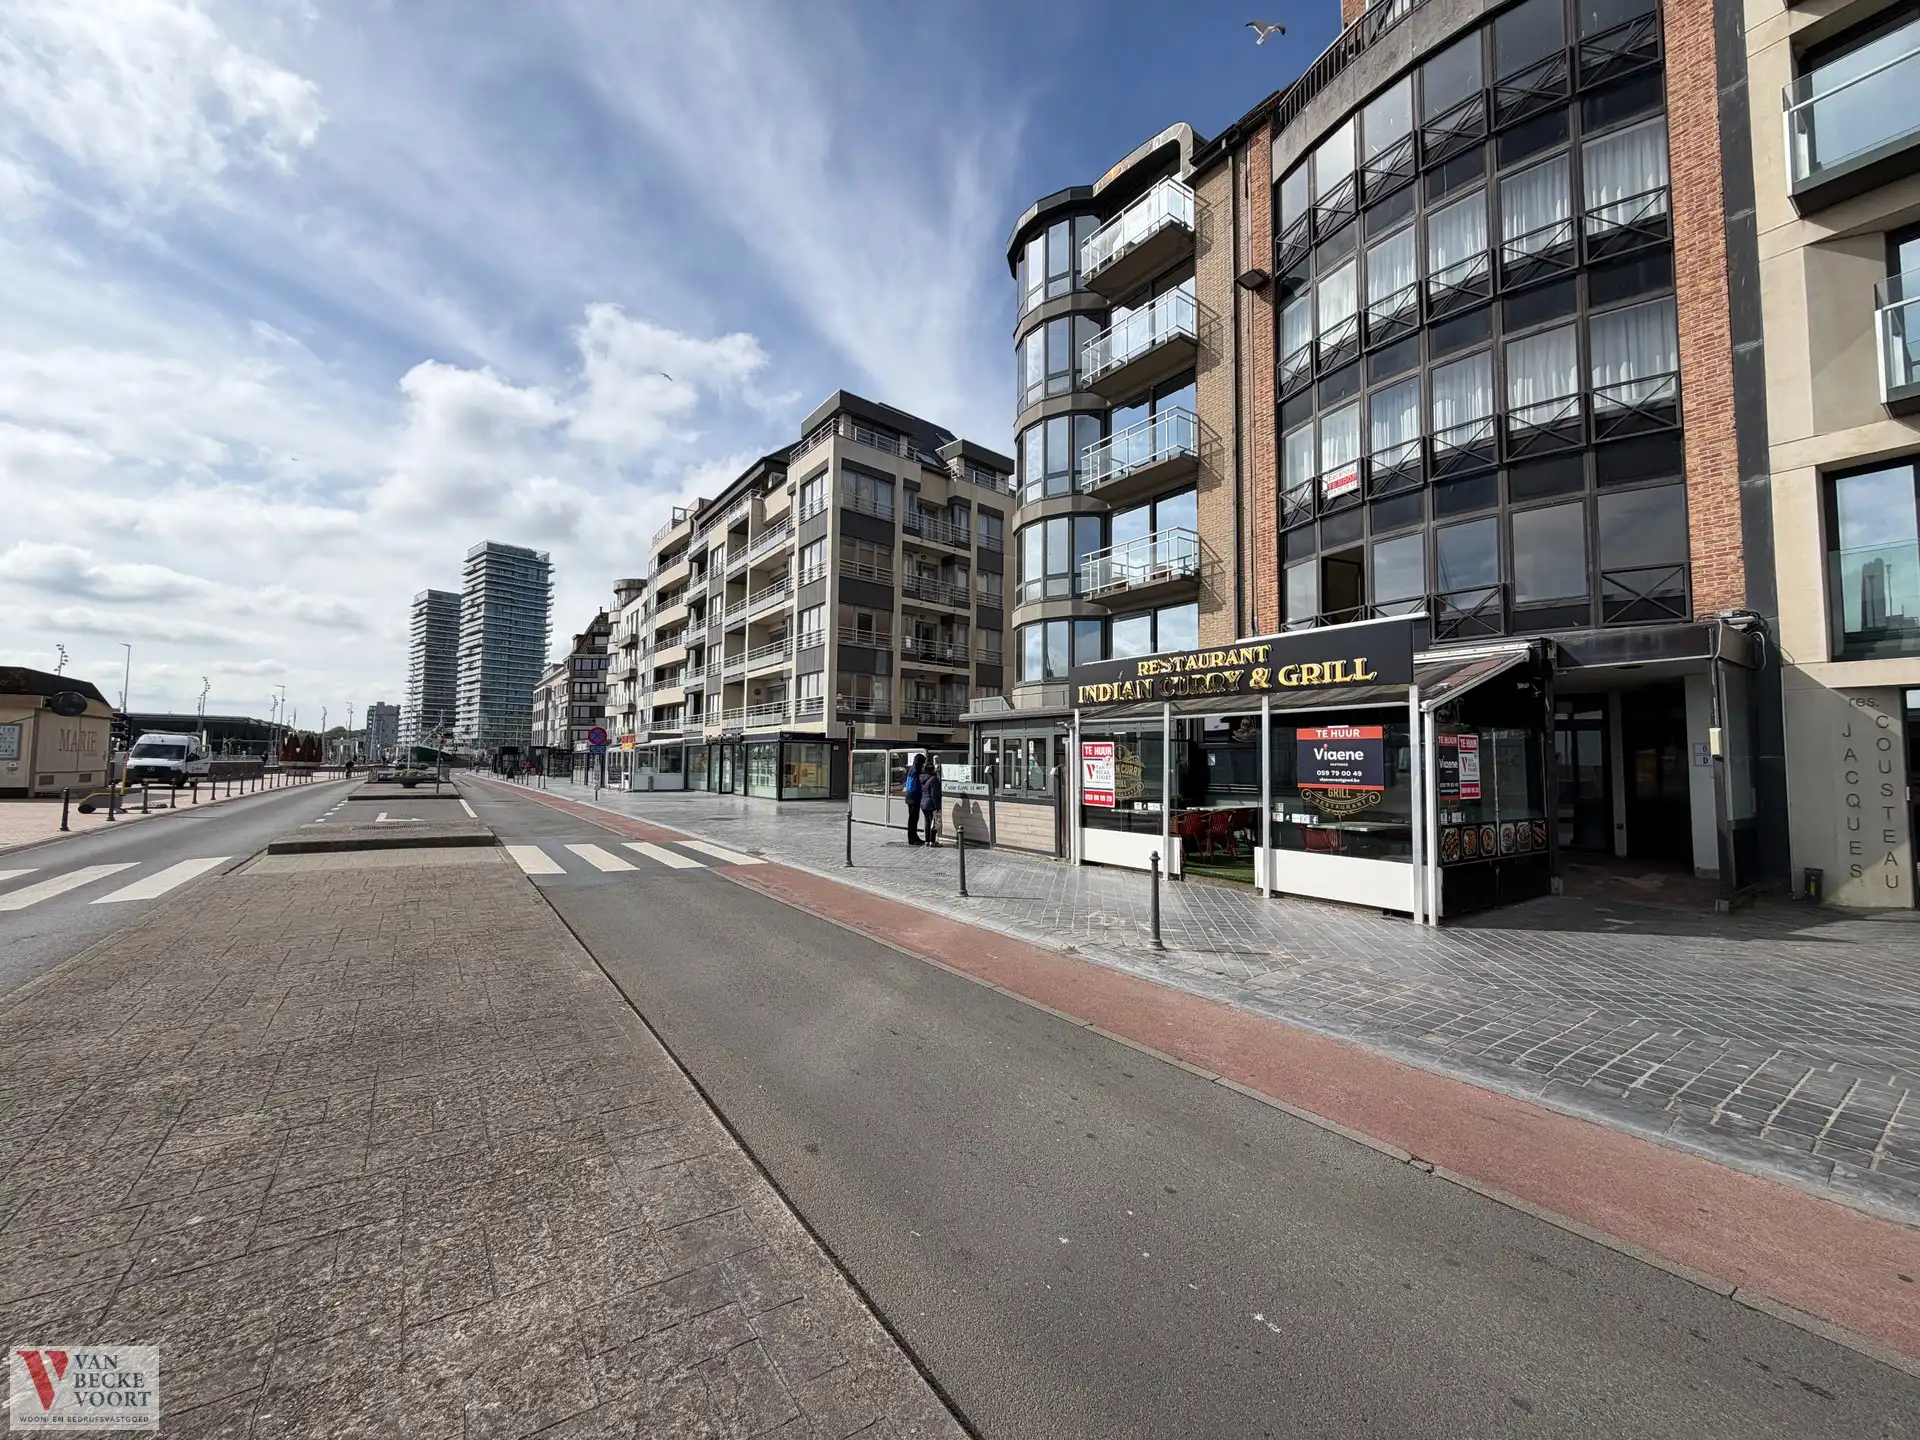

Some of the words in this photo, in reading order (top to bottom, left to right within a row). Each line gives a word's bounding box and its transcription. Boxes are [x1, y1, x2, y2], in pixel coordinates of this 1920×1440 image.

[1137, 644, 1272, 677] RESTAURANT
[1077, 678, 1154, 704] INDIAN
[1160, 669, 1244, 698] CURRY
[1249, 667, 1272, 689] &
[1278, 657, 1378, 687] GRILL
[1849, 697, 1879, 707] res.
[58, 728, 98, 752] MARIE
[1316, 730, 1328, 738] TE
[1331, 729, 1360, 738] HUUR
[1084, 746, 1093, 755] TE
[1094, 746, 1112, 756] HUUR
[1313, 743, 1364, 761] Viaene
[1327, 788, 1351, 798] GRILL
[1842, 722, 1863, 879] JACQUES
[1876, 715, 1899, 889] COUSTEAU
[1315, 798, 1366, 809] RESTAURANT
